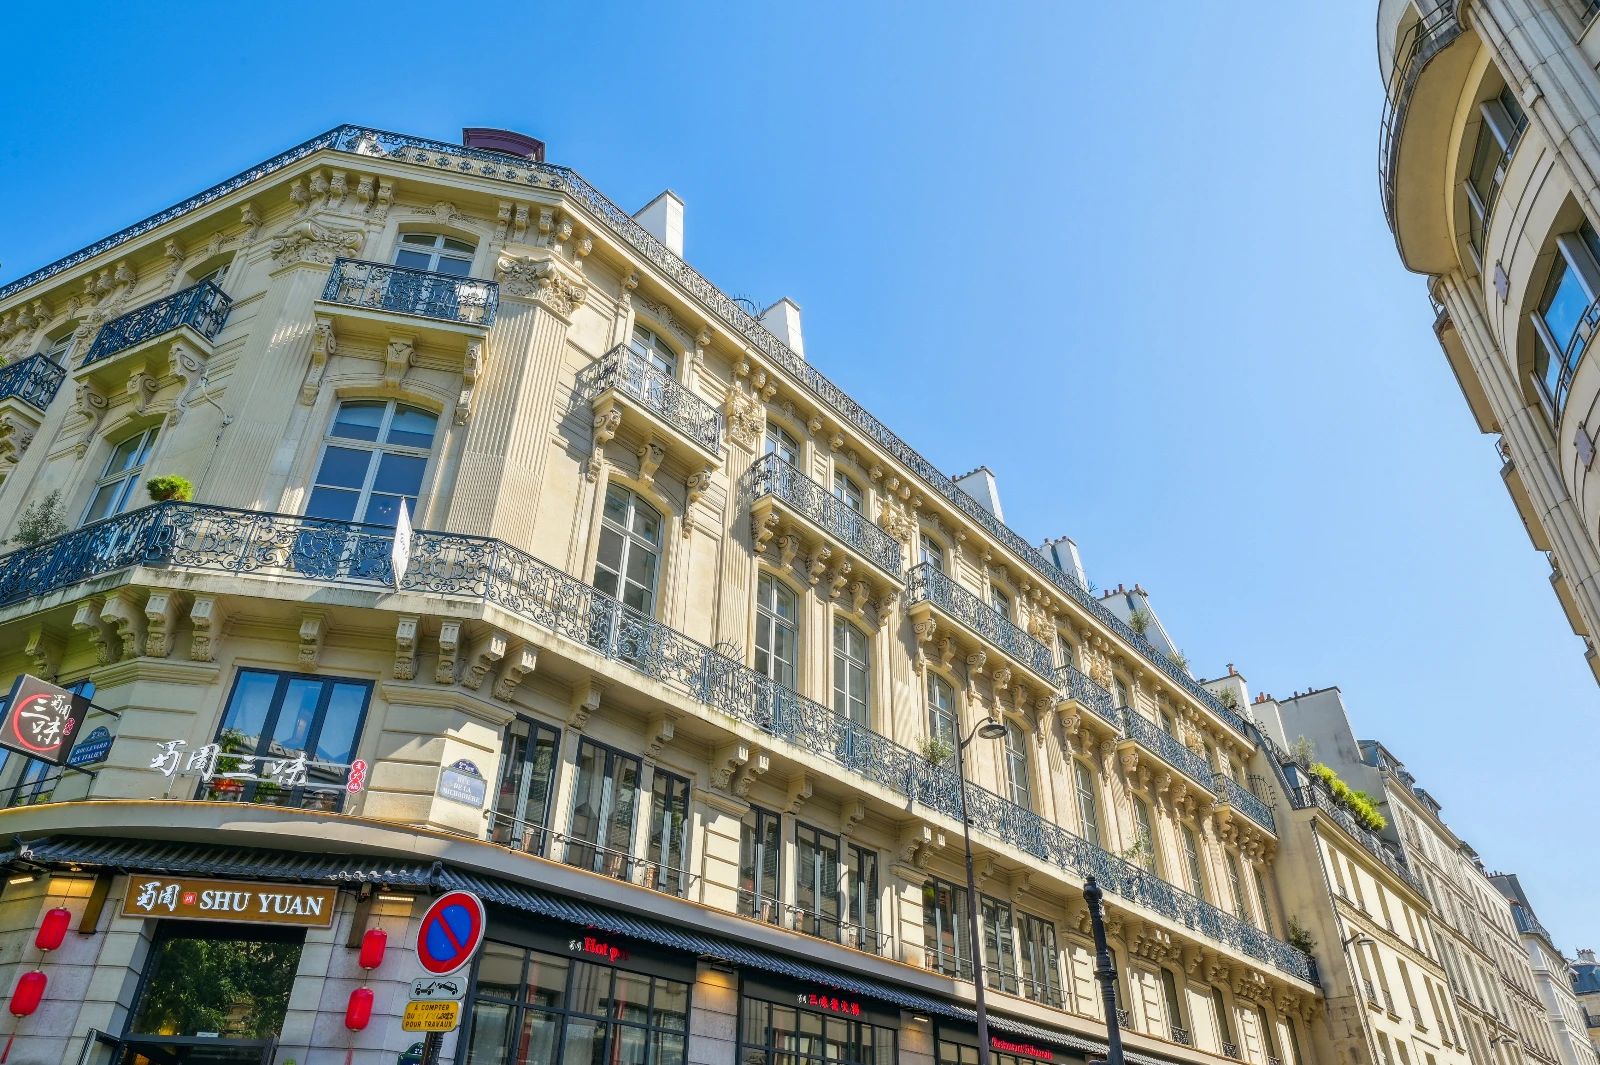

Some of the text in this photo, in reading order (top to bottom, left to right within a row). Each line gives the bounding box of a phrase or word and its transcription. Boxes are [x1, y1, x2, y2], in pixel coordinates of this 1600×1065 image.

[457, 776, 471, 785] RUE
[200, 890, 324, 916] SHU YUAN
[584, 936, 609, 955] Hot
[405, 1020, 452, 1028] POUR TRAVAUX
